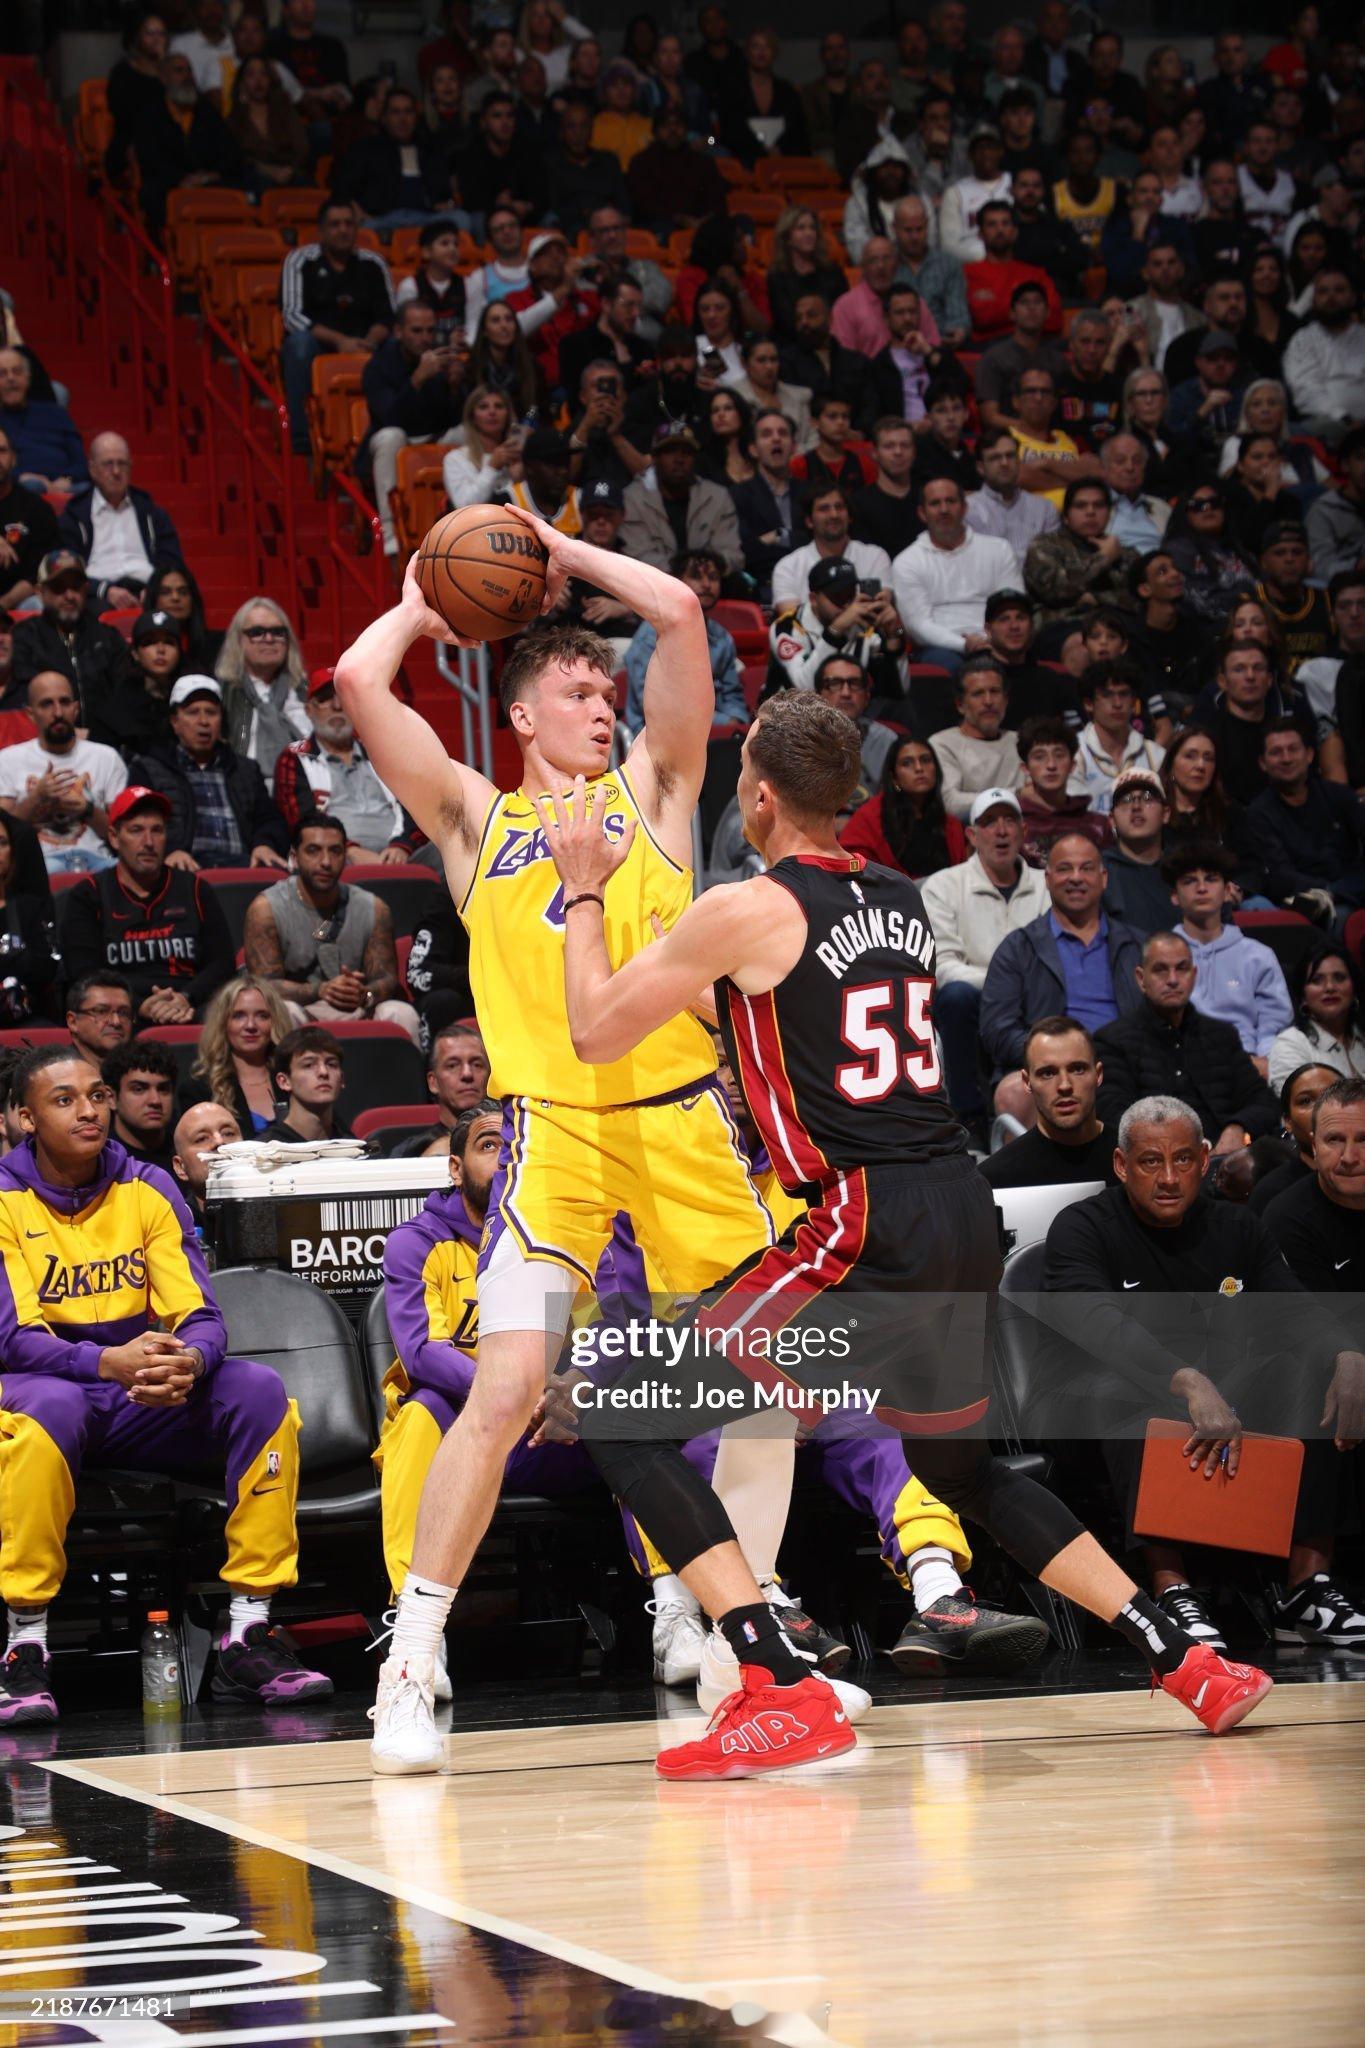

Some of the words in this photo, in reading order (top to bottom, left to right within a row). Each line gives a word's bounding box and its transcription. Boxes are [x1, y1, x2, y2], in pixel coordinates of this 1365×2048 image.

[485, 814, 625, 879] LAKS
[106, 937, 195, 965] CULTURE
[815, 908, 935, 980] ROBINSON
[834, 976, 943, 1104] 55
[38, 1247, 148, 1305] LAKERS
[721, 1711, 809, 1754] AIR
